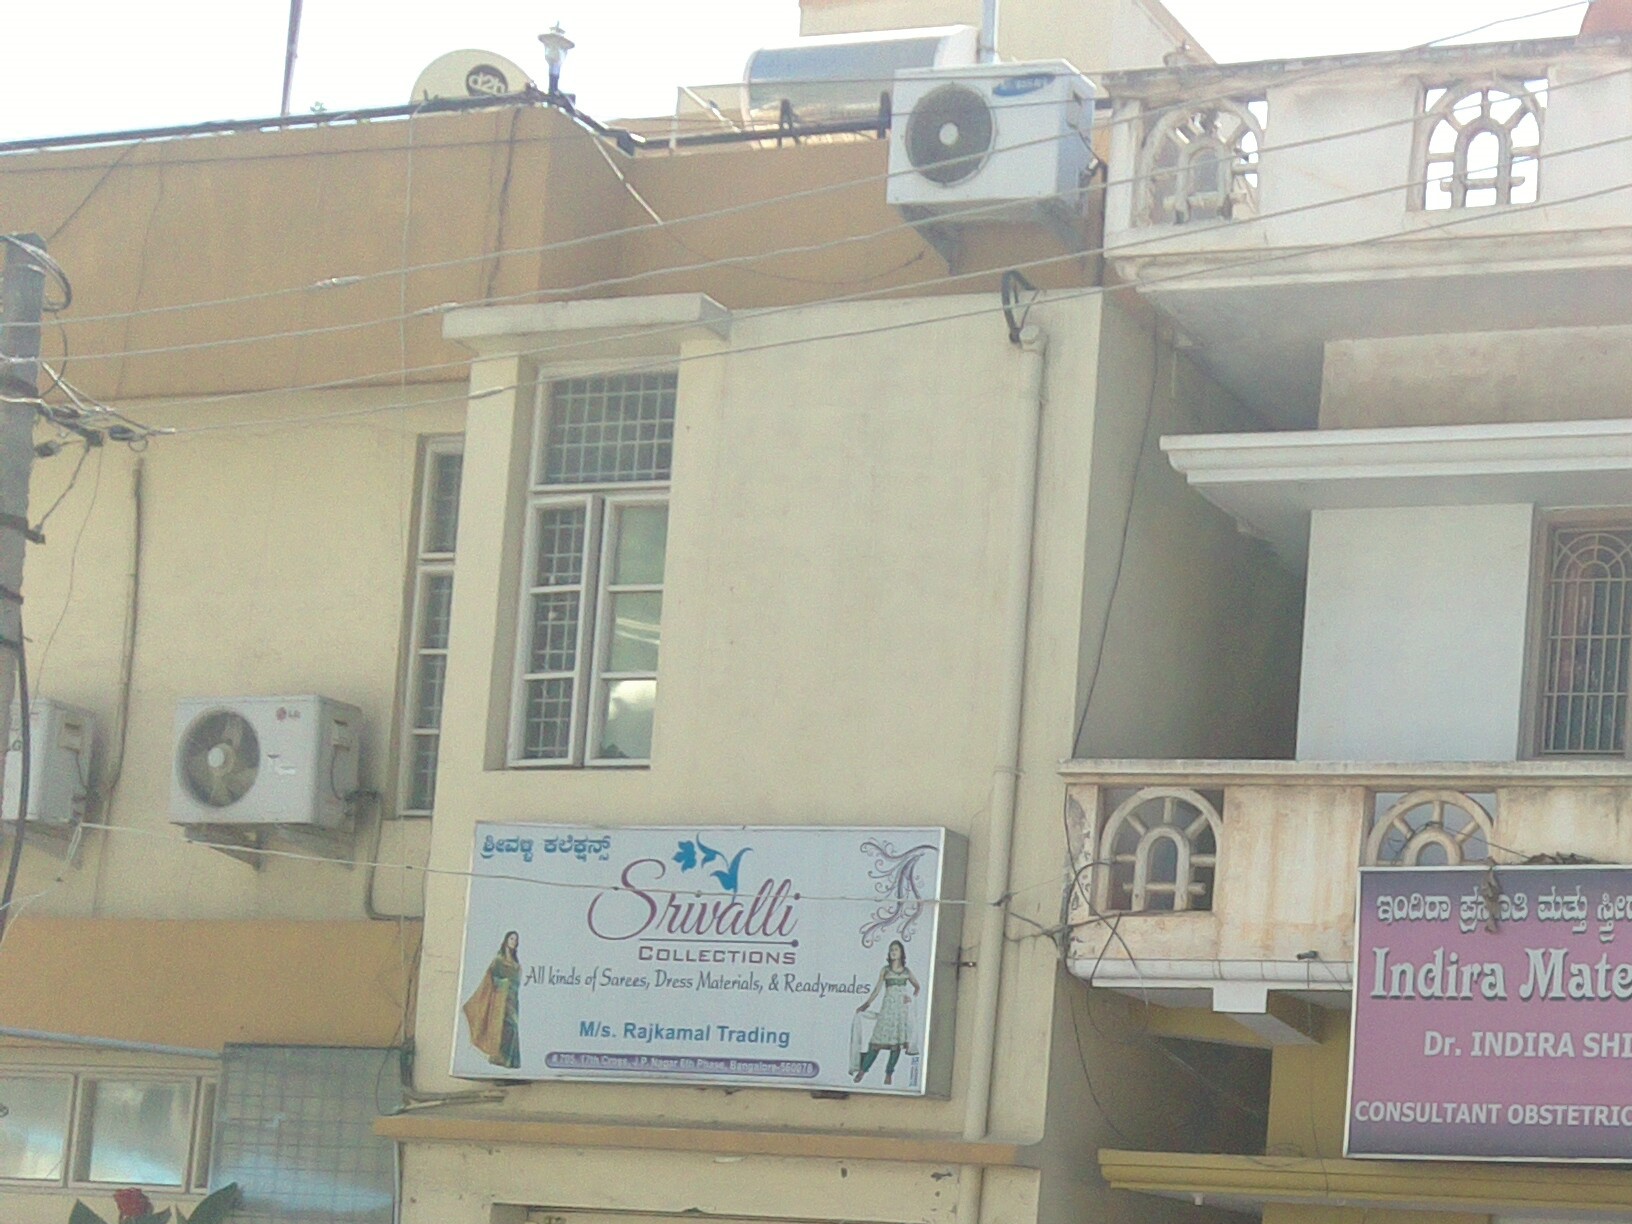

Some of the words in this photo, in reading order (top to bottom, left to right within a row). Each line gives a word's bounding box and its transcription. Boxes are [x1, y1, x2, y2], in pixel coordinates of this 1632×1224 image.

[587, 858, 799, 941] Srivalli
[1376, 892, 1451, 925] ಇಂದಿರಾ
[1537, 886, 1588, 933] ಮತ್ತು
[638, 945, 797, 965] COLLECTIONS
[524, 965, 546, 986] All
[548, 969, 582, 987] kinds
[584, 967, 599, 992] of
[601, 967, 650, 990] Sarees,
[654, 969, 694, 990] Dress
[695, 969, 764, 993] Materials,
[769, 975, 779, 991] &
[783, 974, 871, 997] Readymades
[1370, 946, 1508, 1001] Indira
[579, 1020, 617, 1038] M/s.
[623, 1022, 711, 1042] Rajkamal
[716, 1025, 791, 1048] Trading
[1423, 1029, 1462, 1057] Dr.
[1470, 1031, 1575, 1058] INDIRA
[1354, 1100, 1503, 1125] CONSULTANT
